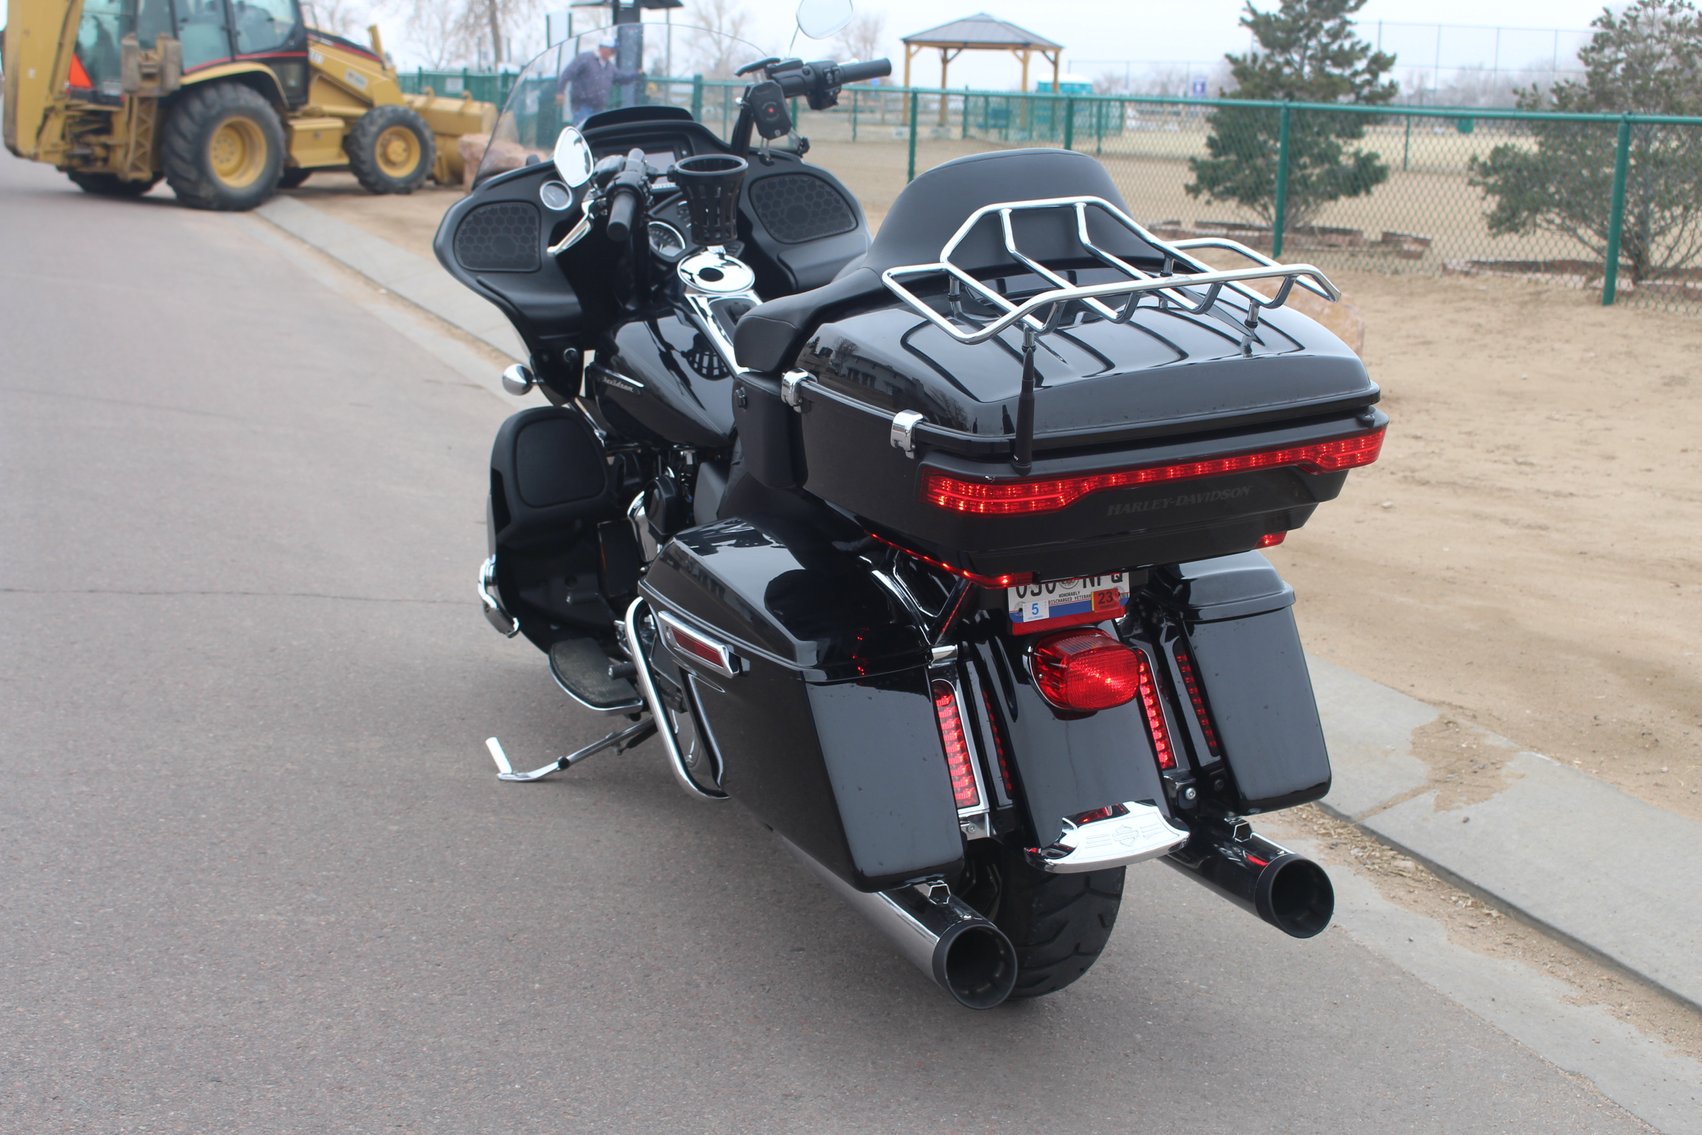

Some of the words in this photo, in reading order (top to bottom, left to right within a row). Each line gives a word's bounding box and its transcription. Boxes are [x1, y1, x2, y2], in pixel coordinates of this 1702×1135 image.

[1106, 485, 1252, 516] HARLEY-DAVIDSON
[1097, 591, 1114, 605] 23
[1031, 602, 1039, 615] 5
